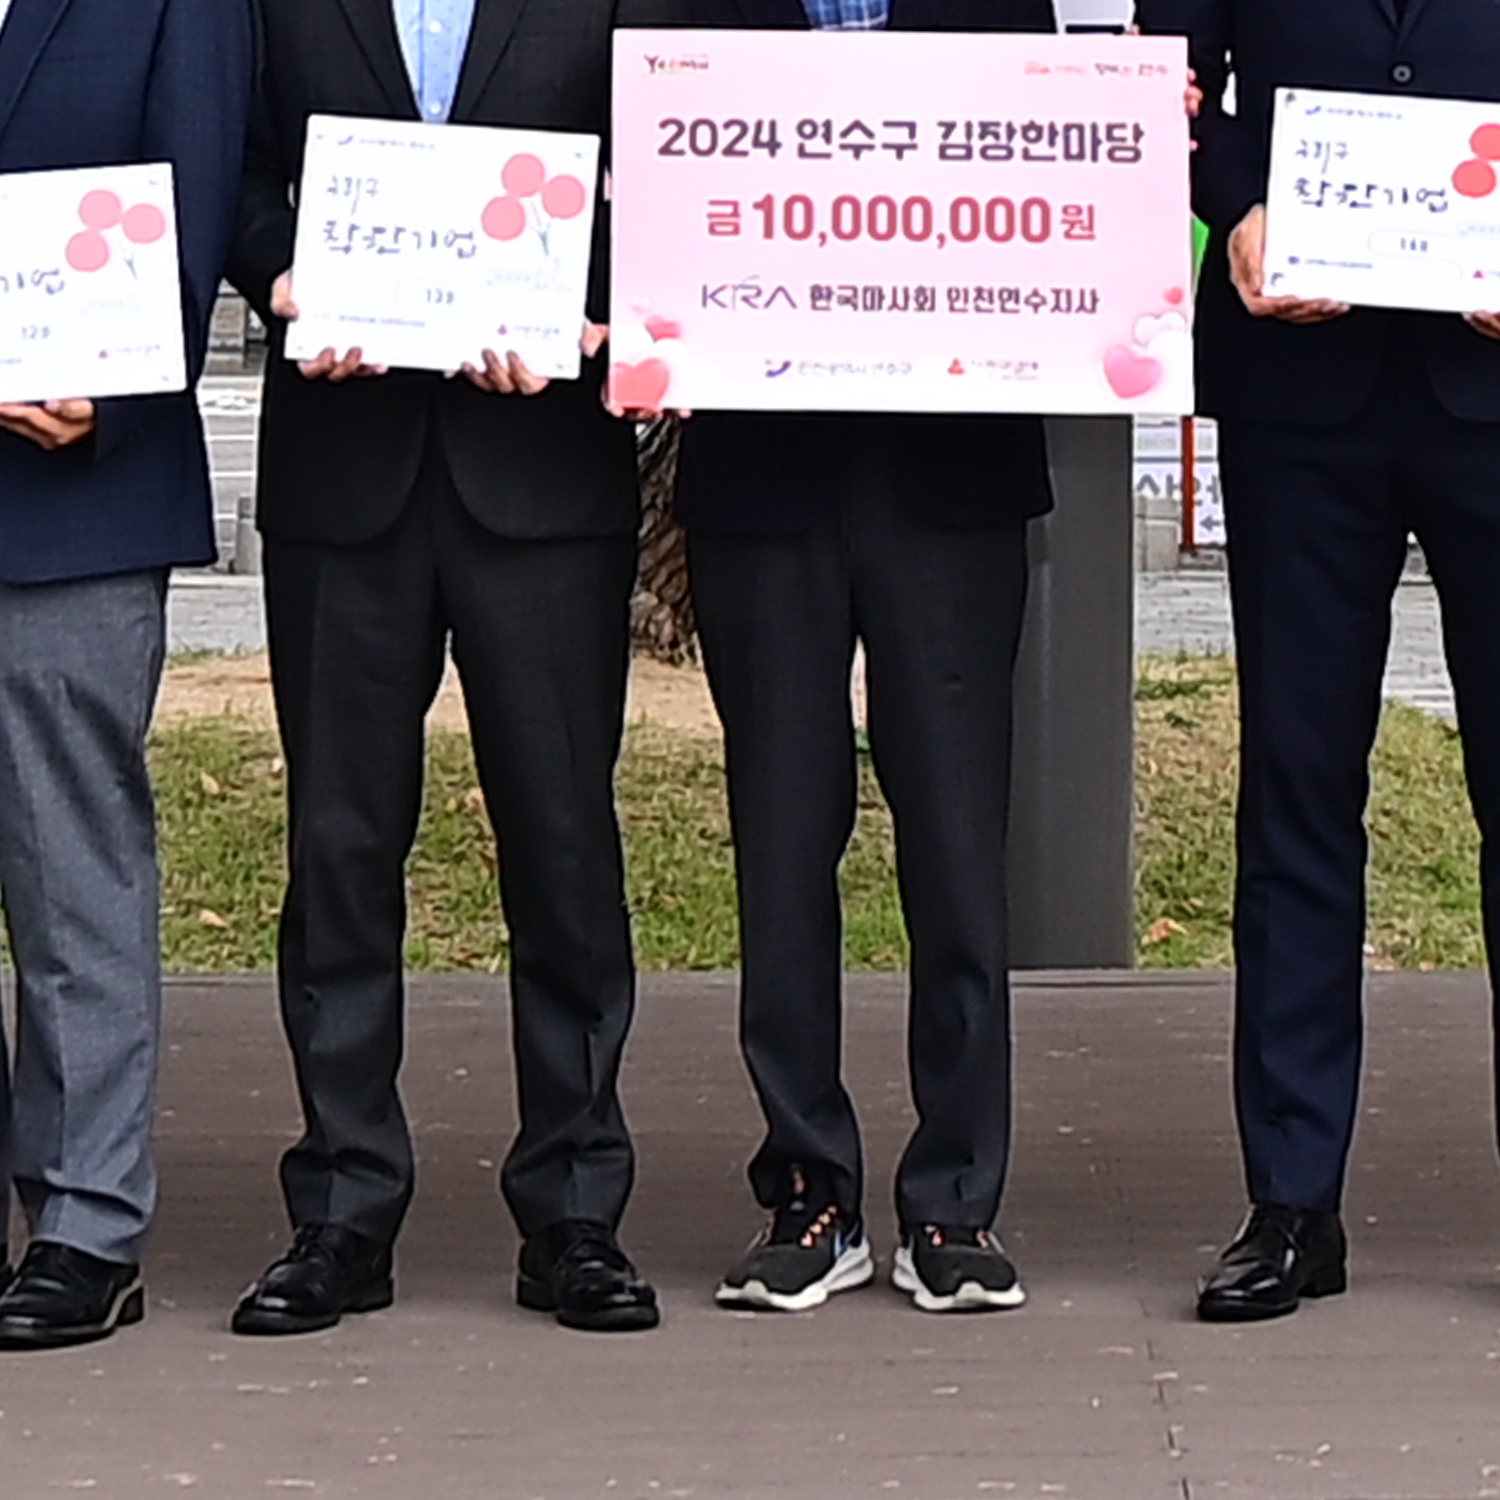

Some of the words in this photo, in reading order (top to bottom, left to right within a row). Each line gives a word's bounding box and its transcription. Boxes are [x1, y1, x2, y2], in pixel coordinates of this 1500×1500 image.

[657, 117, 782, 158] 2024
[796, 119, 918, 161] 연수구
[937, 119, 1144, 163] 김장한마당
[701, 275, 798, 311] KRA
[809, 284, 937, 315] 한국마사회
[946, 284, 1100, 316] 인천연수지사
